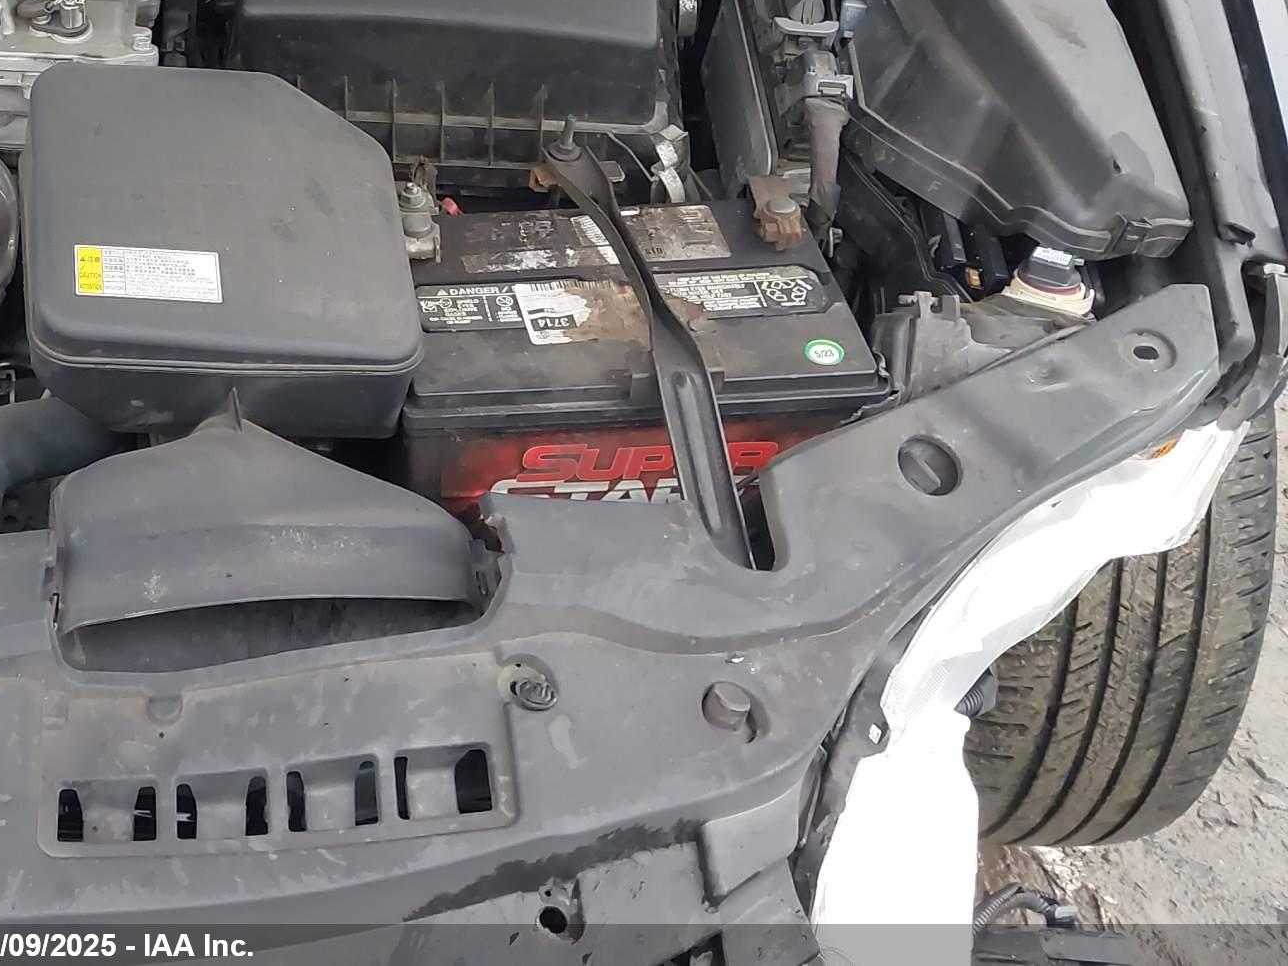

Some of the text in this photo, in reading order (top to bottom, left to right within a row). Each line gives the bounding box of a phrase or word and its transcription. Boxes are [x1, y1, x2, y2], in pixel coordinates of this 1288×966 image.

[449, 286, 500, 296] DANGER
[537, 317, 571, 328] 3714
[516, 442, 778, 482] SUPR
